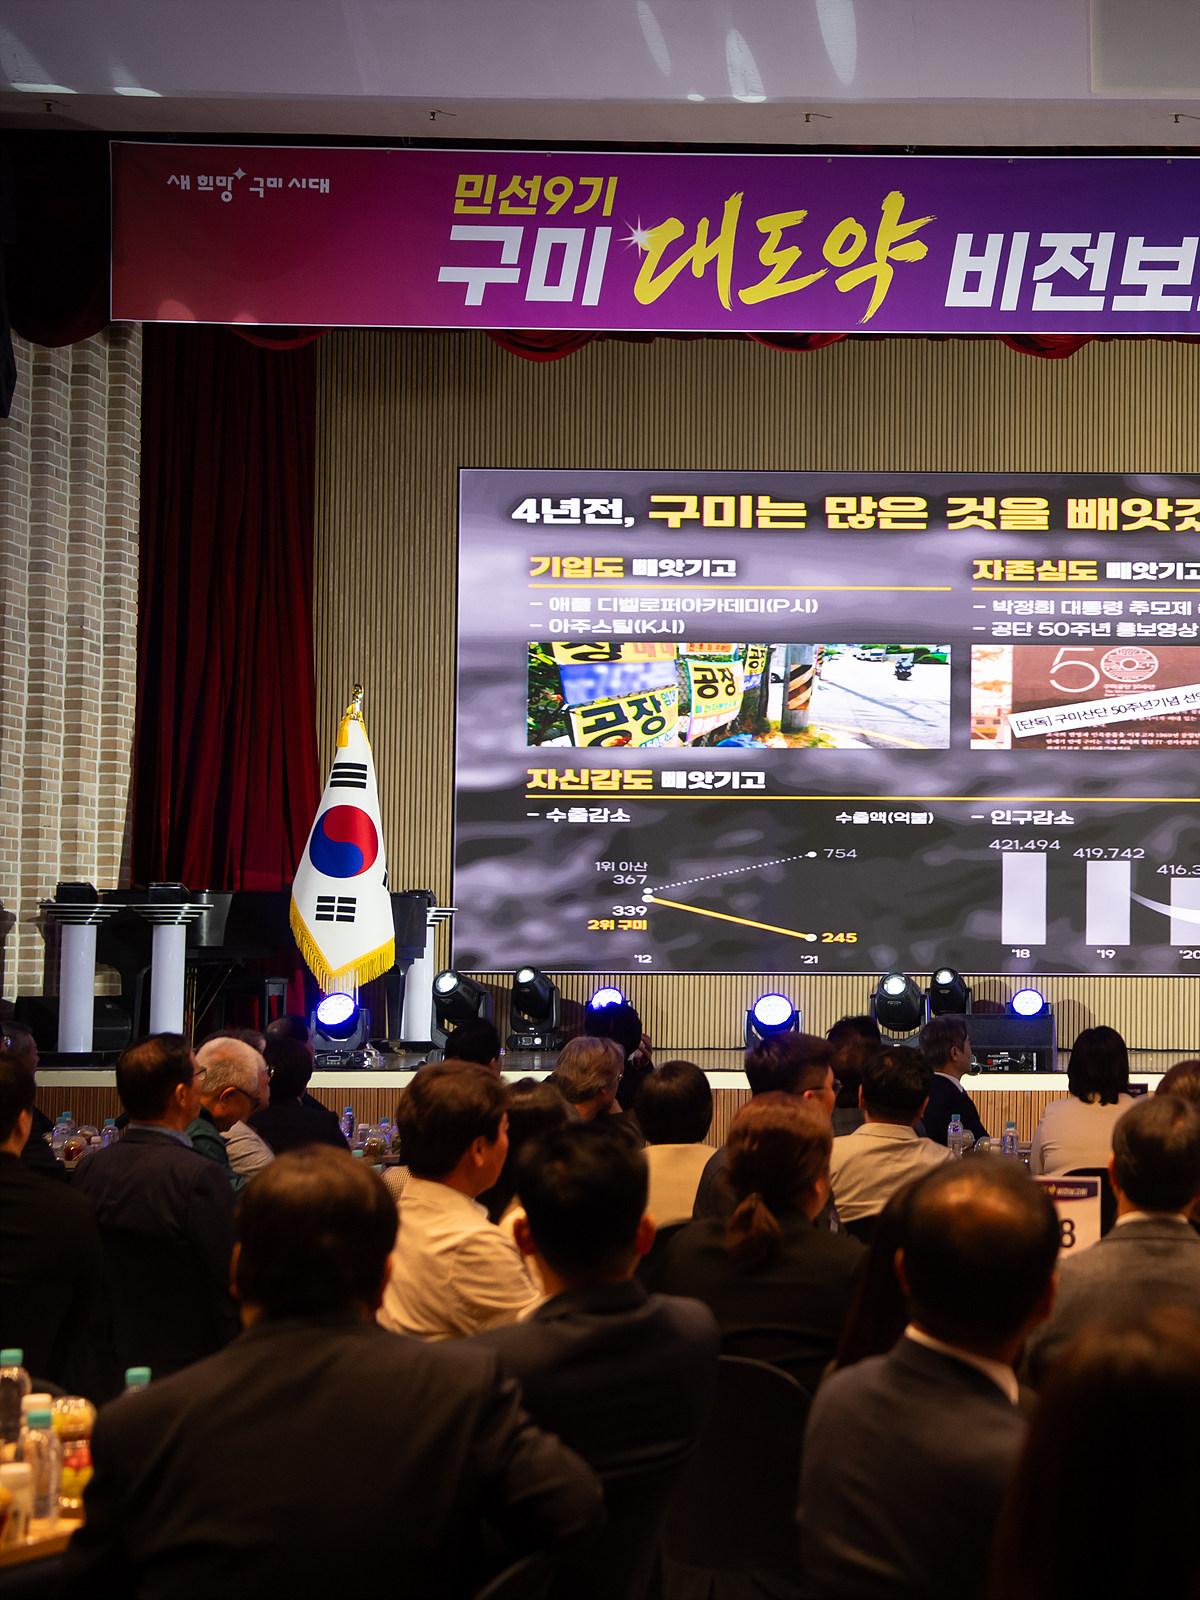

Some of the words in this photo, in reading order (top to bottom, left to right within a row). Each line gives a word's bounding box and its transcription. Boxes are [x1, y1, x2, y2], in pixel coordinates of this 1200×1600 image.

[167, 174, 190, 190] 새
[197, 174, 234, 202] 희망
[250, 177, 283, 198] 구미
[288, 177, 330, 194] 시대
[453, 175, 617, 216] 민선9기
[437, 225, 612, 306] 구미
[633, 190, 937, 325] 대도약
[512, 498, 634, 528] 4년전,
[648, 495, 806, 529] 구미는
[824, 495, 928, 530] 많은
[946, 497, 1049, 531] 것을
[529, 557, 624, 578] 기업도
[632, 559, 736, 578] 빼앗기고
[972, 559, 1098, 582] 자존심도
[992, 600, 1054, 615] 박정희
[1061, 600, 1123, 616] 대통령
[1129, 600, 1191, 616] 추모제
[991, 621, 1033, 637] 공단
[1038, 621, 1111, 637] 50주년
[1116, 622, 1198, 638] 홍보영상
[1055, 707, 1107, 724] 구미산단
[1111, 695, 1180, 716] 50주년기념
[526, 768, 653, 791] 자신감도
[661, 771, 766, 790] 빼앗기고
[546, 807, 630, 823] 수출감소
[990, 810, 1074, 825] 인구감소
[824, 849, 857, 858] 754
[595, 861, 615, 872] 1위
[619, 861, 648, 872] 아산
[613, 875, 647, 885] 367
[612, 906, 647, 916] 339
[587, 919, 615, 931] 2위
[617, 920, 648, 931] 구미
[821, 932, 858, 943] 245
